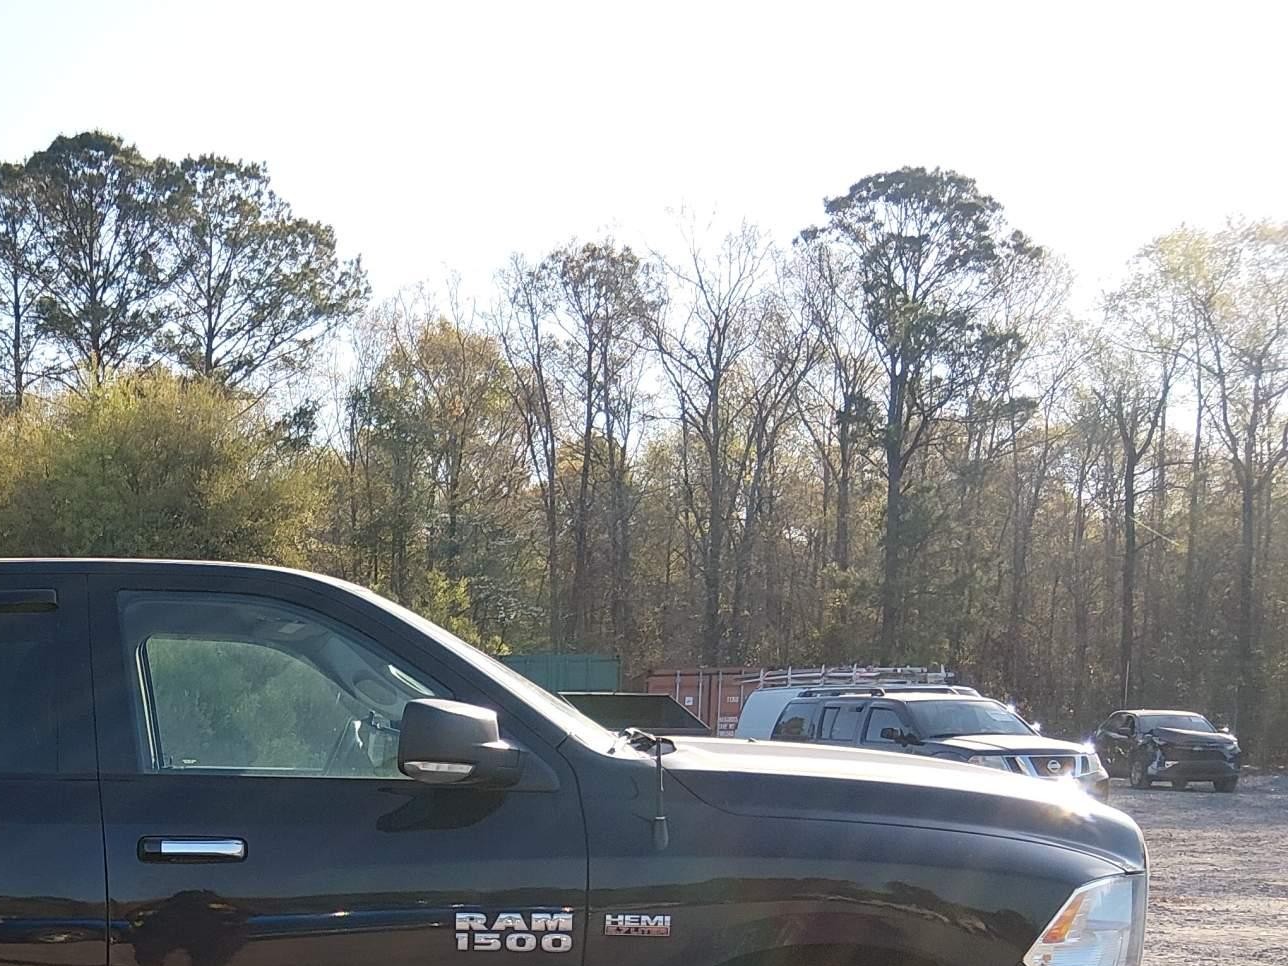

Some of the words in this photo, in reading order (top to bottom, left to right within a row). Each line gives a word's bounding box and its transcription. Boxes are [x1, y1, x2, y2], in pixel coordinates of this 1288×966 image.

[455, 912, 573, 931] RAM
[605, 914, 671, 926] HEMI
[455, 933, 573, 953] 1500
